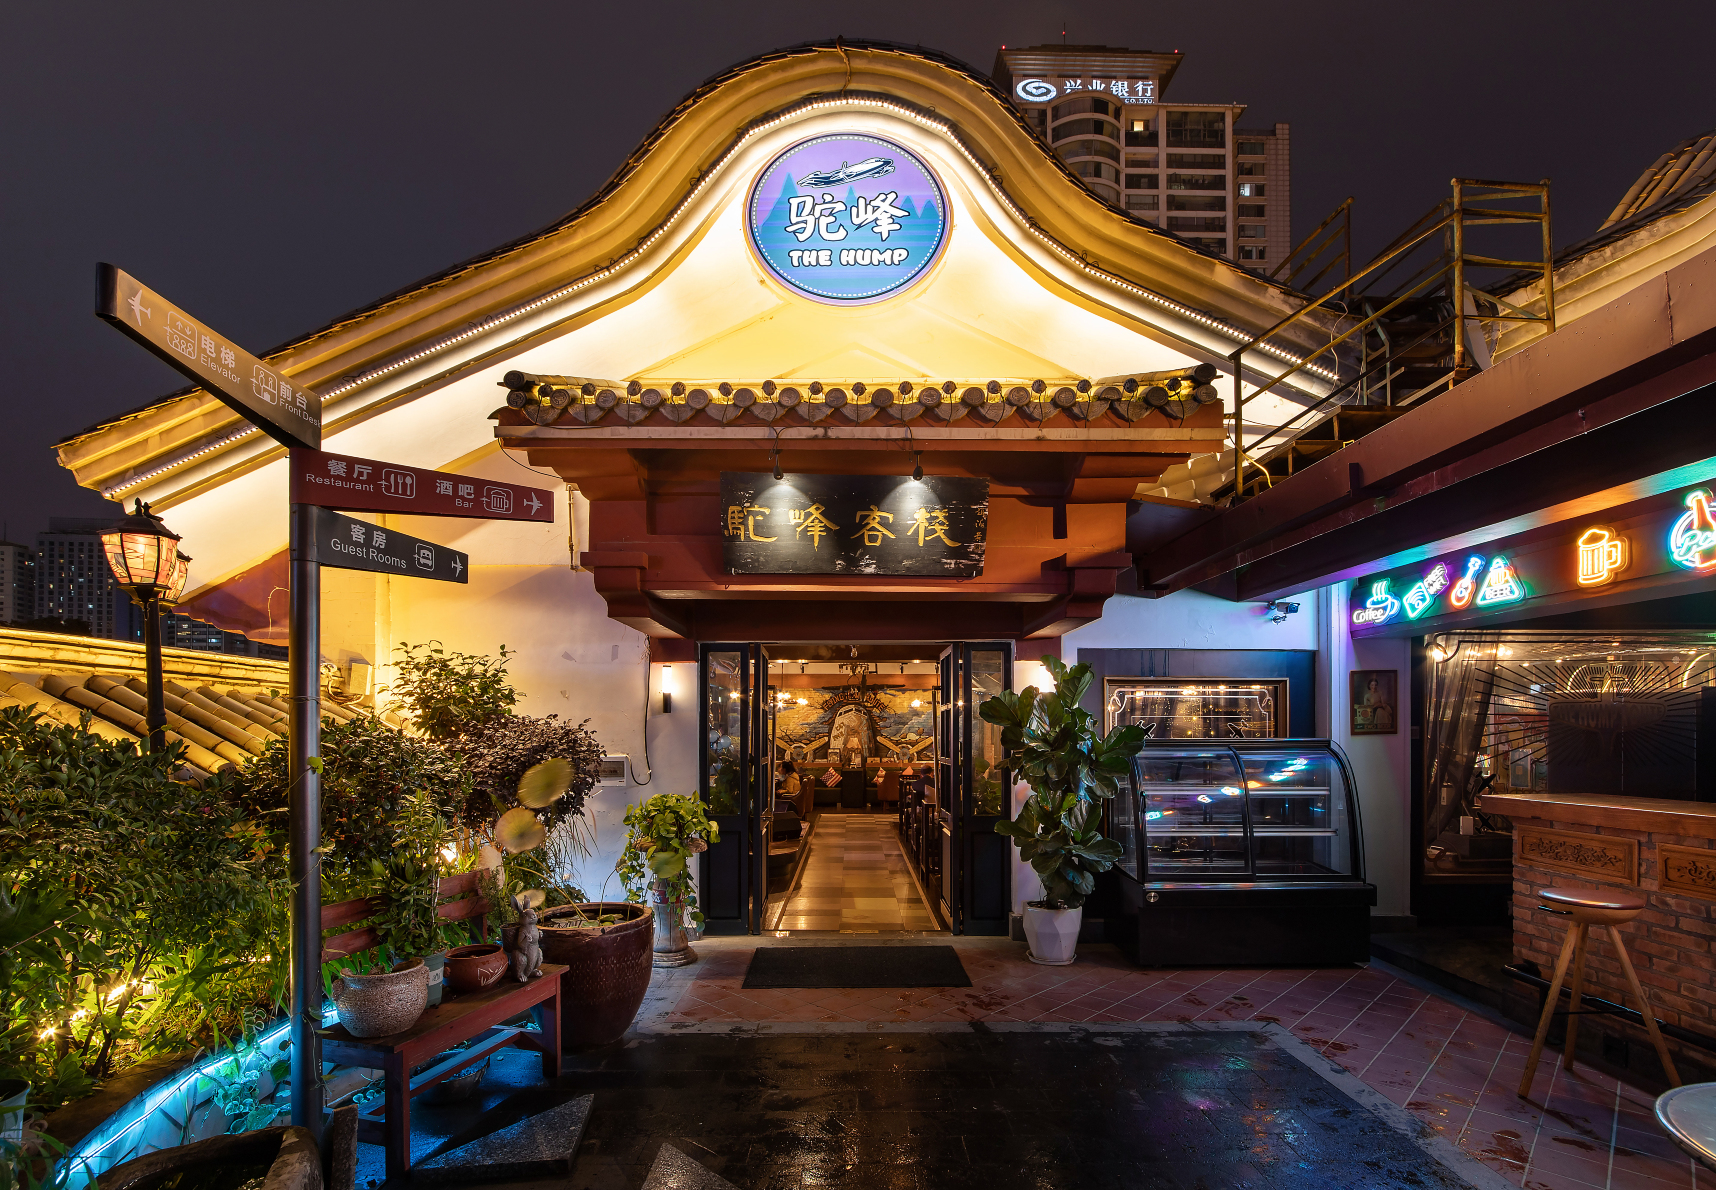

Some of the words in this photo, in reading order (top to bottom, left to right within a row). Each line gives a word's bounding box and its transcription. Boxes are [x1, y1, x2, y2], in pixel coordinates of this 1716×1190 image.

[1064, 79, 1154, 96] 兴业银行
[784, 191, 911, 243] 驼峰
[788, 249, 833, 267] THE
[839, 248, 909, 266] HUMP
[201, 334, 236, 369] 电梯
[200, 353, 241, 384] Elevator
[279, 381, 308, 410] 前台
[280, 398, 302, 417] Front
[302, 411, 322, 429] Desk
[327, 459, 373, 480] 餐厅
[306, 473, 374, 492] Restaurant
[435, 479, 475, 499] 酒吧
[455, 498, 474, 509] Bar
[350, 523, 387, 549] 客房
[330, 538, 367, 559] Guest
[369, 548, 407, 569] Rooms
[1485, 584, 1511, 599] BEER
[1352, 608, 1383, 623] Coffee
[1578, 703, 1619, 728] HUMP
